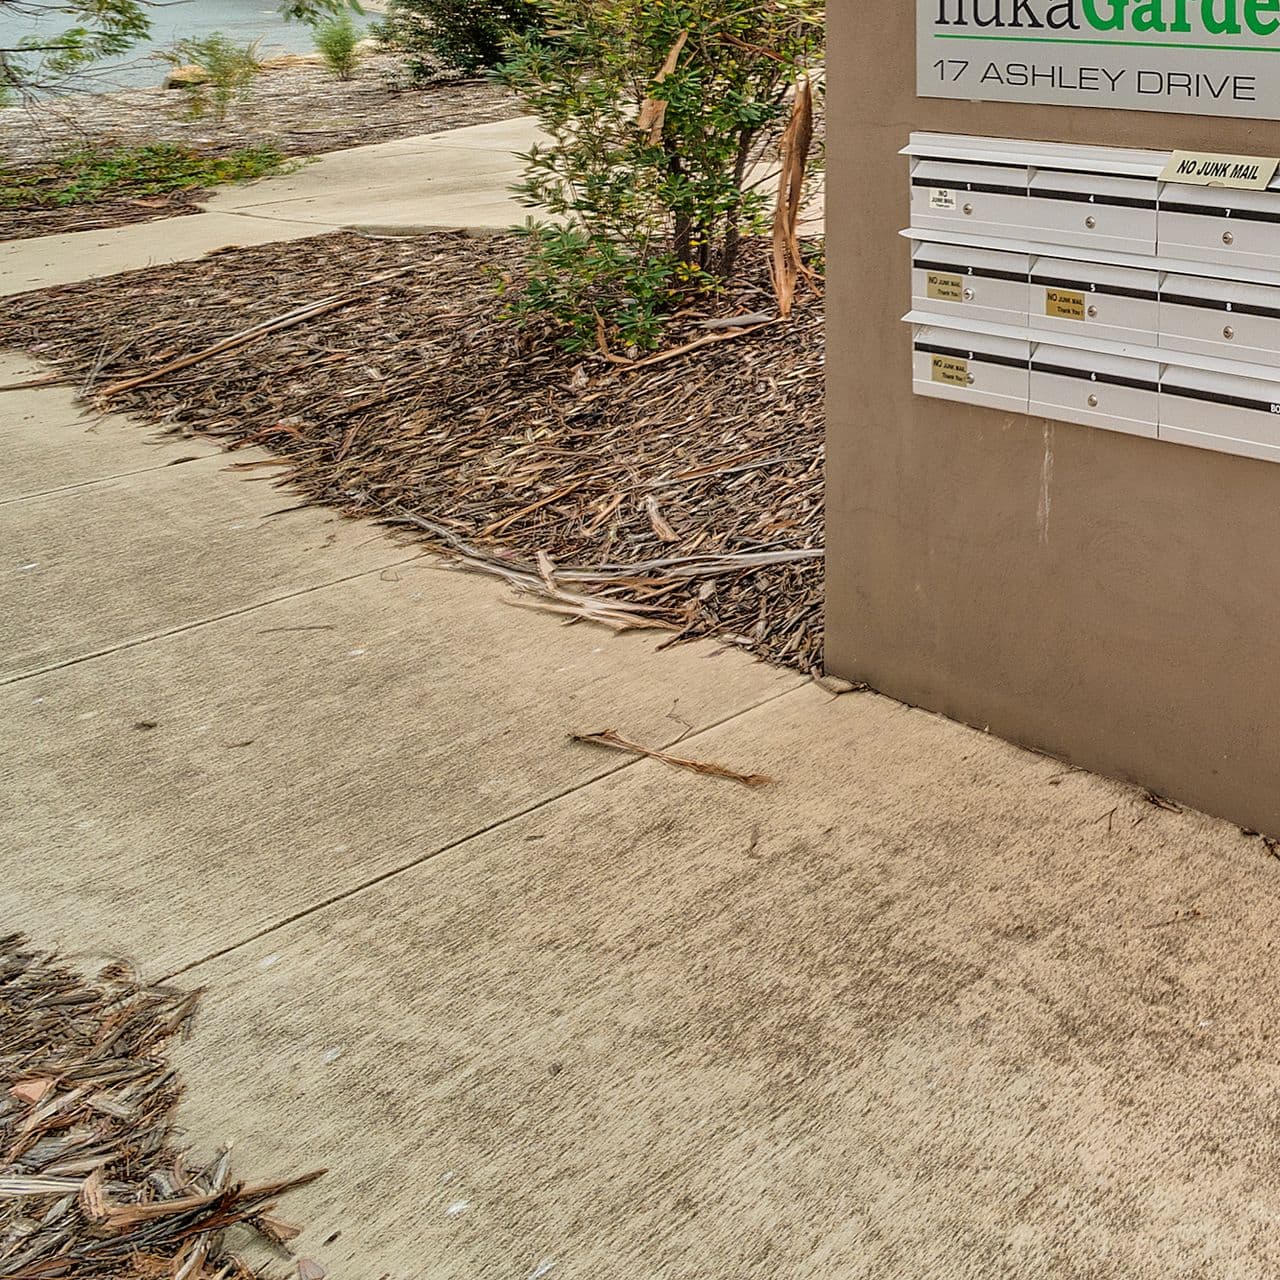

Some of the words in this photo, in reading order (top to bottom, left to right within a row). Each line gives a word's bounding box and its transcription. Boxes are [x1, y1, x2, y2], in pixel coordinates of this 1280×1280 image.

[933, 59, 969, 82] 17
[979, 62, 1127, 92] ASHLEY
[1136, 70, 1257, 101] DRIVE
[1176, 159, 1198, 175] NO
[1197, 161, 1232, 179] JUNK
[1229, 163, 1260, 180] MAIL
[966, 183, 972, 191] 1
[1088, 194, 1095, 204] 4
[1224, 208, 1232, 218] 7
[967, 267, 973, 276] 2
[1089, 283, 1096, 292] 5
[1047, 292, 1058, 302] NO
[1226, 302, 1232, 312] 8
[968, 351, 974, 360] 3
[933, 359, 943, 368] NO
[1090, 371, 1097, 381] 6
